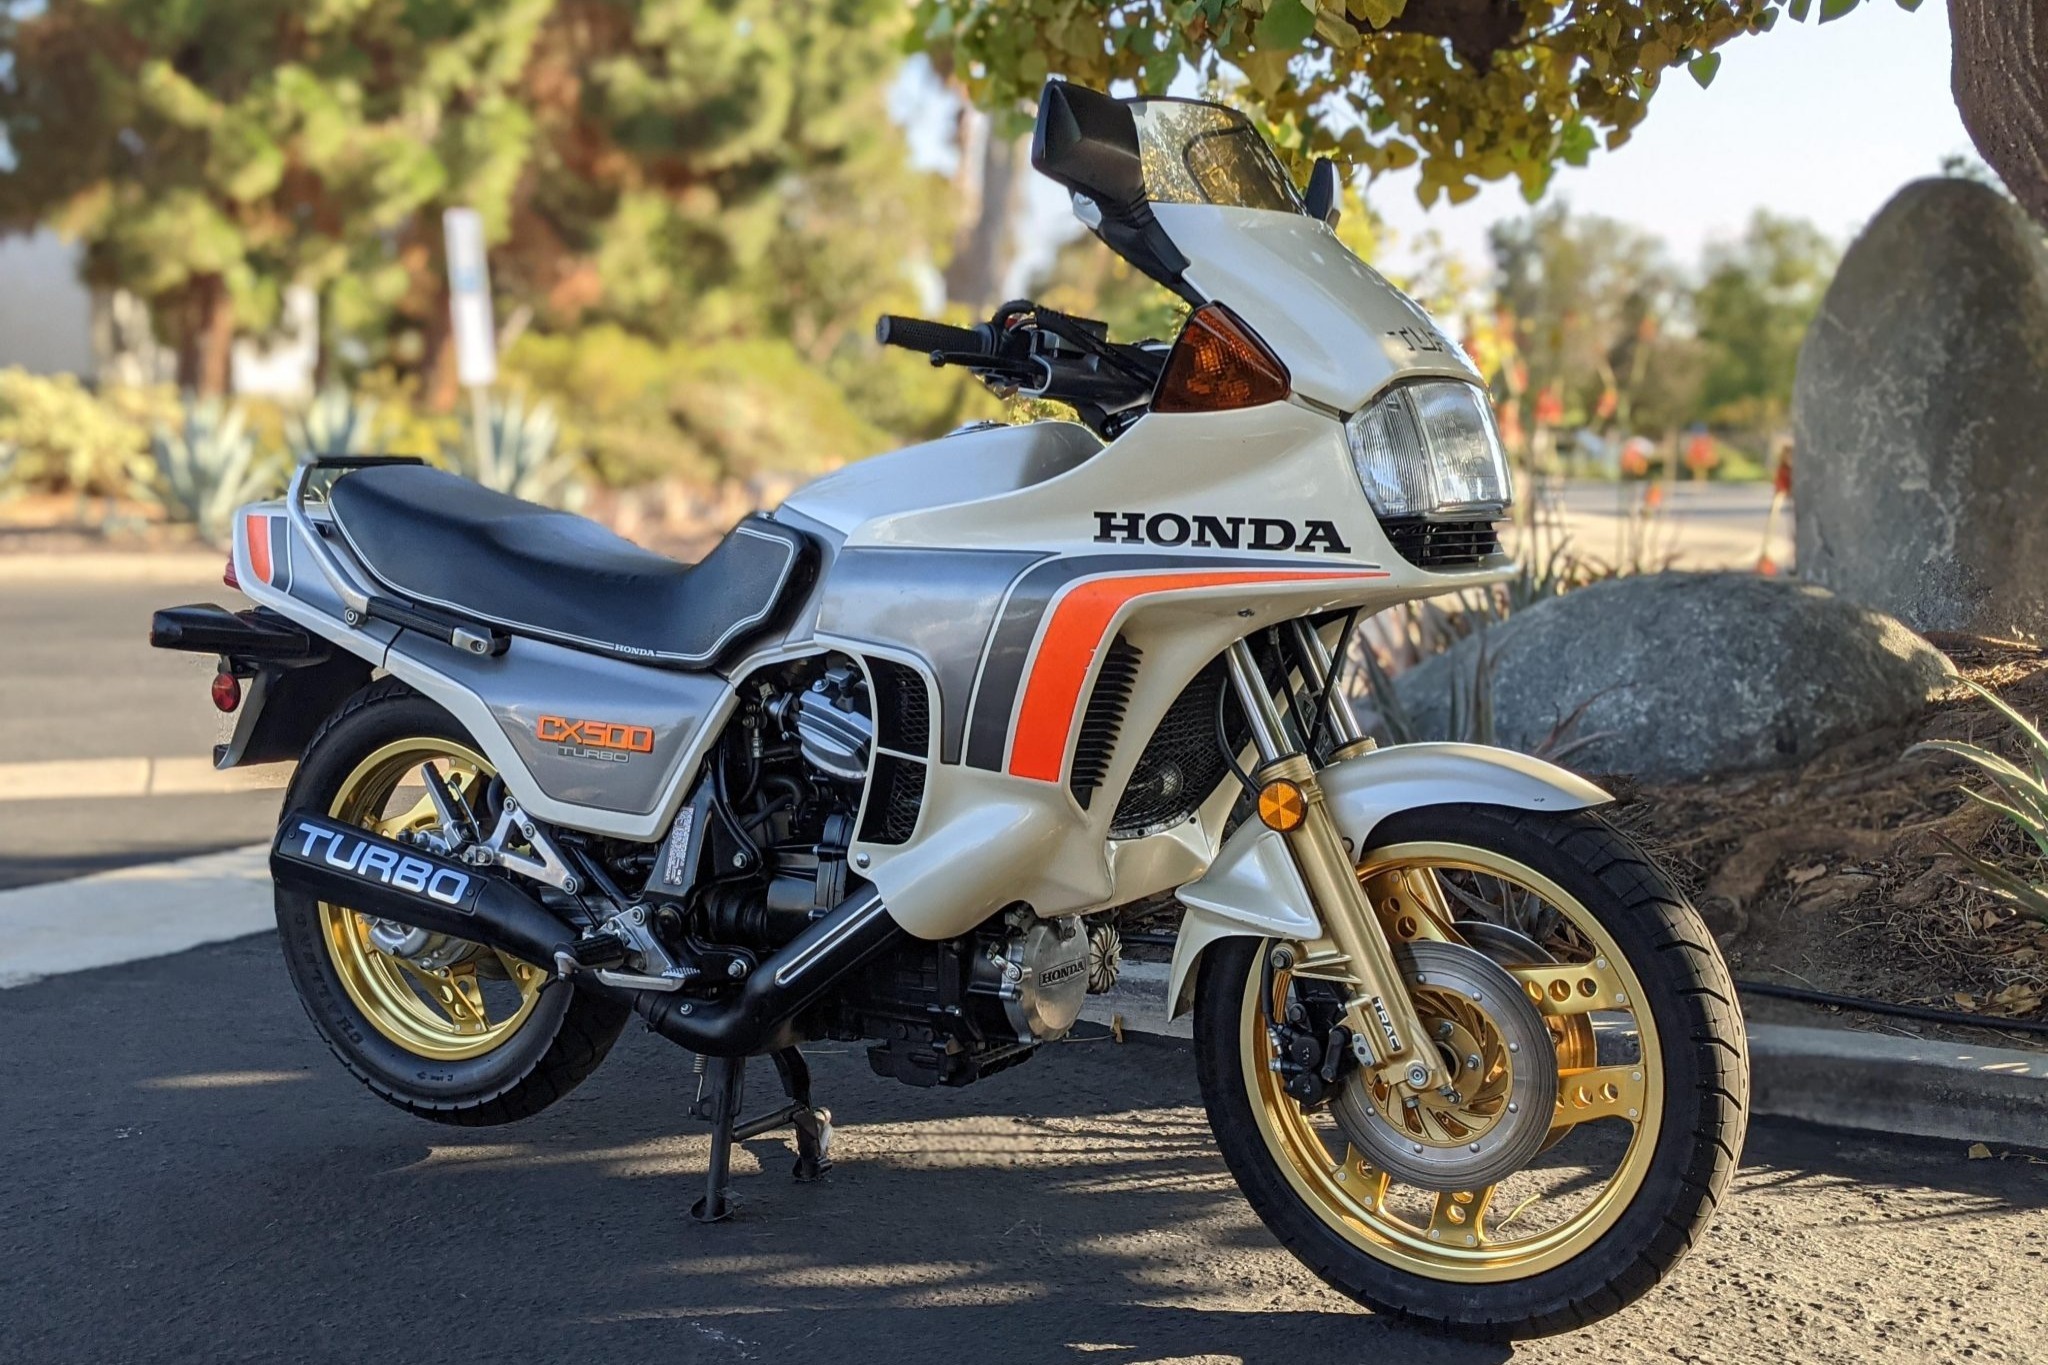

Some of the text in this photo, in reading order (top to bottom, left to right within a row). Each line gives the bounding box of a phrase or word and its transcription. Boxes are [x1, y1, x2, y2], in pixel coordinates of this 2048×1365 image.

[1093, 511, 1352, 554] HONDA
[614, 643, 655, 657] HONDA
[537, 714, 655, 755] CX500
[558, 745, 629, 763] TURBO
[298, 822, 470, 905] TURBO
[1041, 961, 1085, 984] HONDA
[1374, 997, 1400, 1049] TRAC
